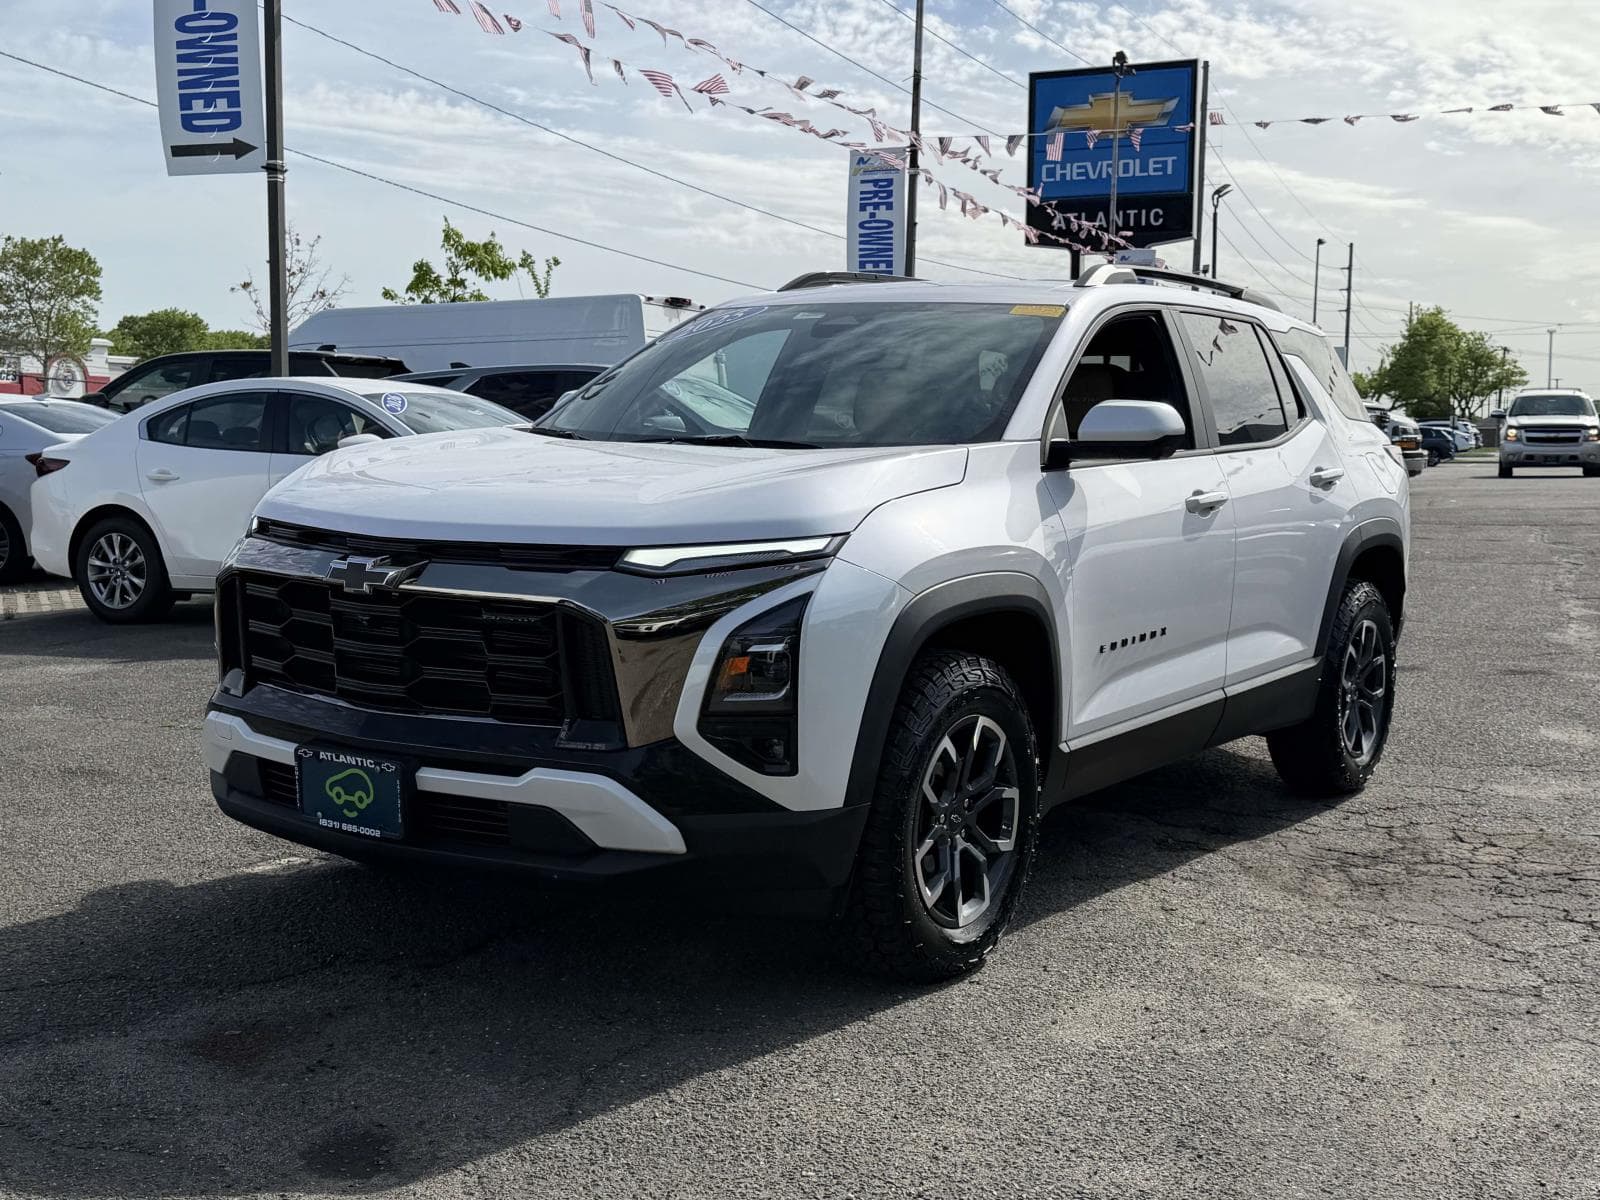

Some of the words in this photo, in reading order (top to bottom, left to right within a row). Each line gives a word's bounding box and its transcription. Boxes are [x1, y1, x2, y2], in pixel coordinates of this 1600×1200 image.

[1041, 156, 1178, 182] CHEVROLET
[1051, 208, 1165, 231] ATLANTIC
[1099, 626, 1167, 654] EQUINOX
[319, 751, 376, 769] ATLANTIC
